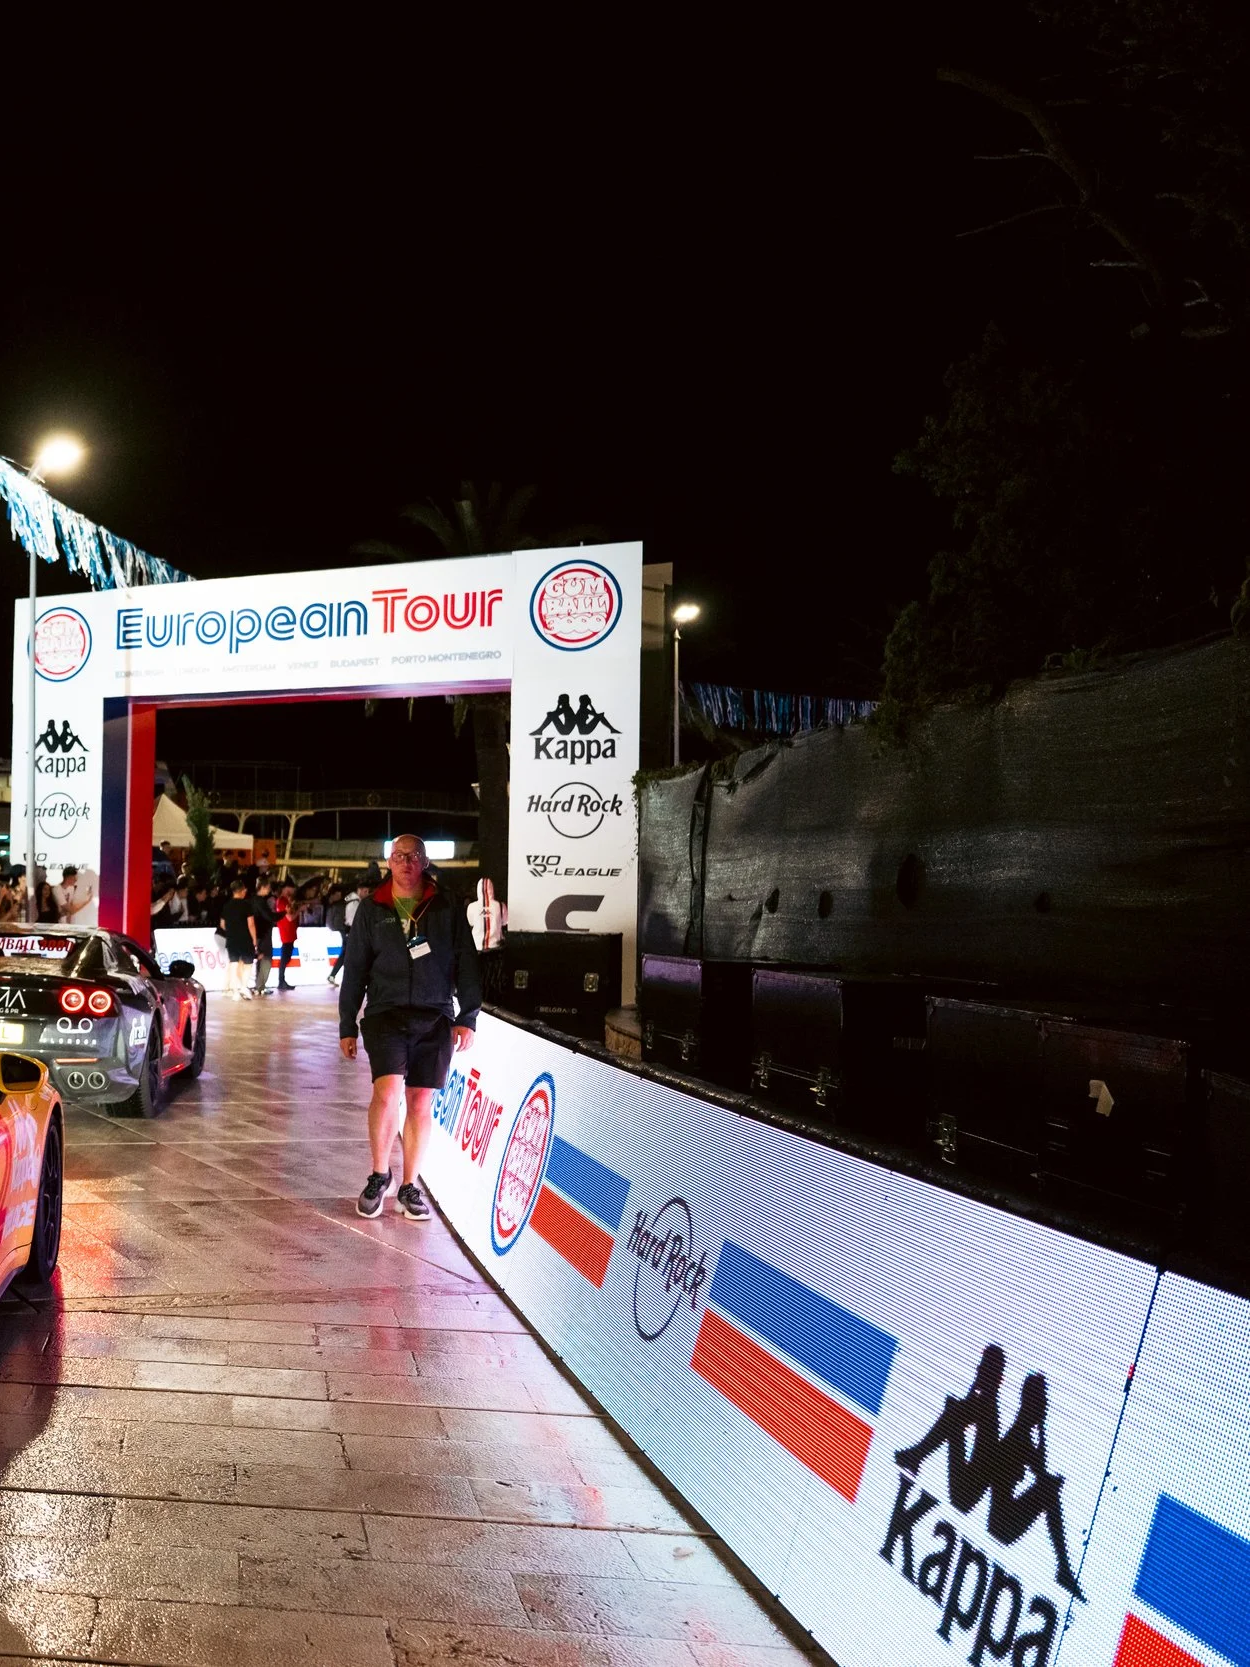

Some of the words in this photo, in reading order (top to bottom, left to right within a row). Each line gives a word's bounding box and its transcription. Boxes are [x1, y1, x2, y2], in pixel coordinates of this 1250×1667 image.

[116, 600, 368, 653] European
[372, 588, 502, 633] Tour
[330, 657, 381, 668] BUDAPEST
[391, 654, 426, 664] PORTO
[427, 650, 502, 663] MONTENEGRO
[534, 737, 616, 765] Kappa
[60, 802, 90, 820] Rock
[527, 795, 573, 812] Hard
[577, 794, 623, 816] Rock
[454, 1067, 503, 1168] Tour
[627, 1210, 672, 1269] Hard
[662, 1234, 707, 1310] Rock
[880, 1472, 1059, 1667] Kappa
